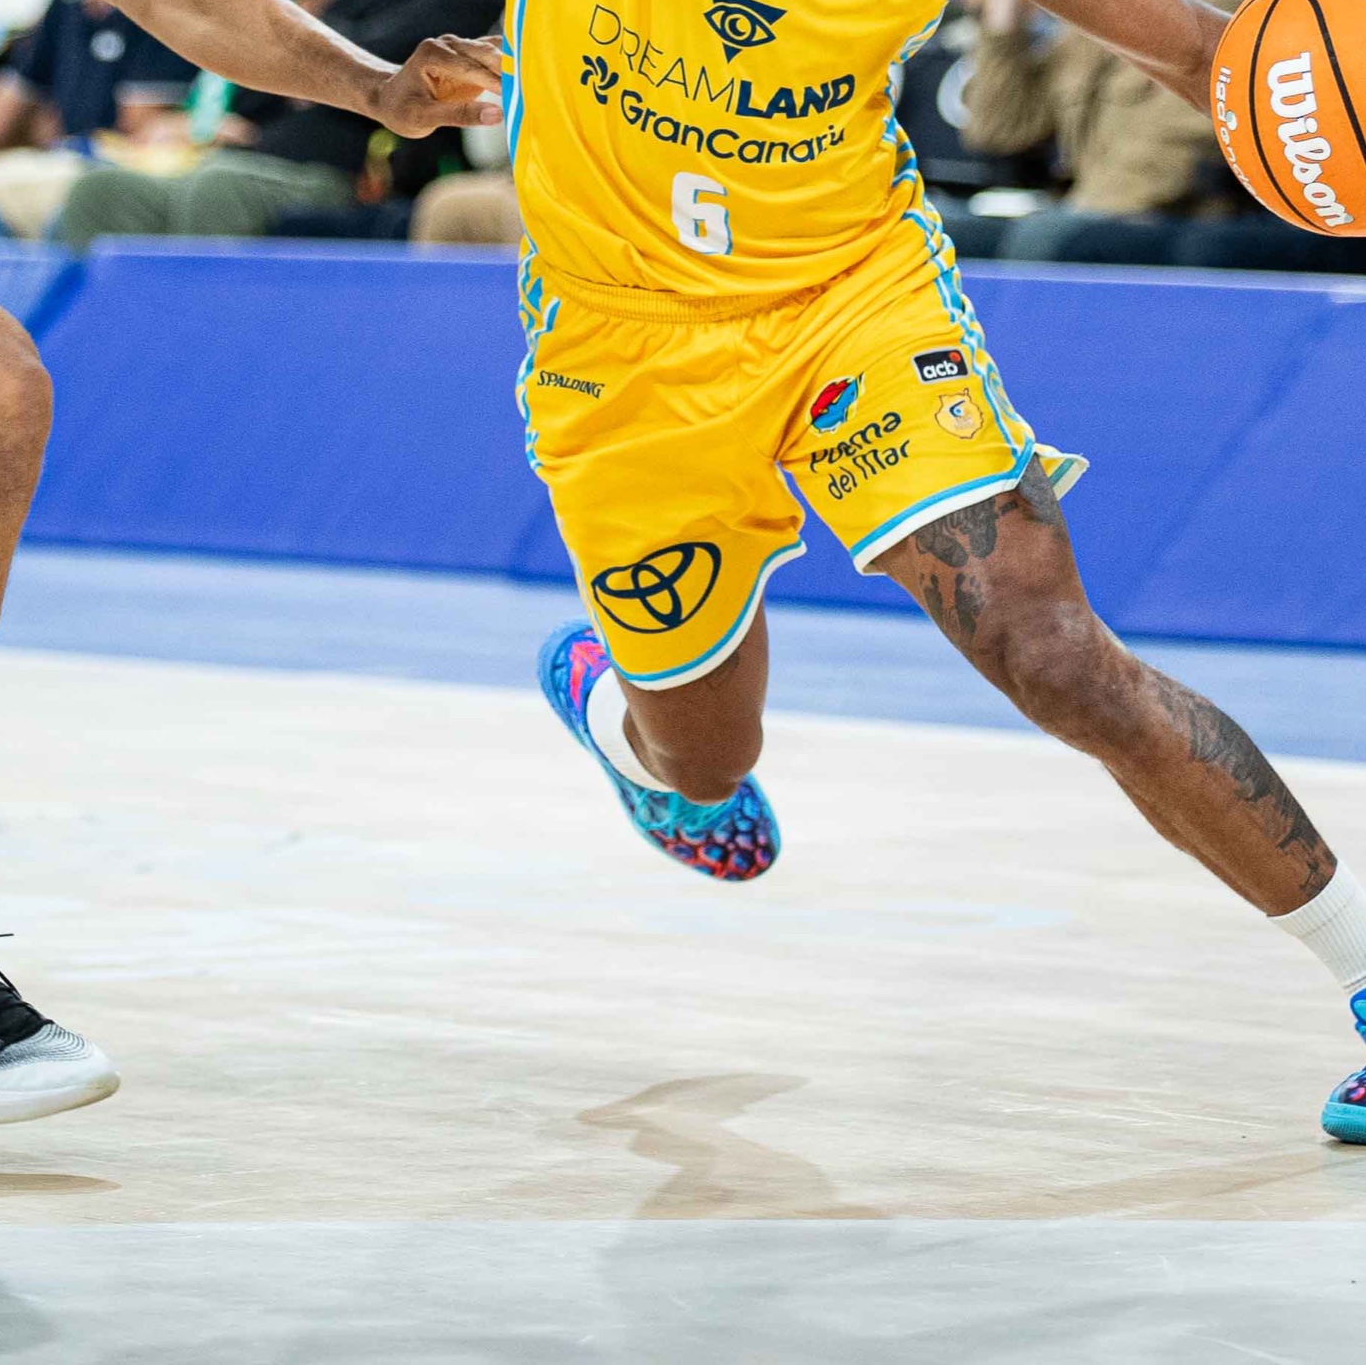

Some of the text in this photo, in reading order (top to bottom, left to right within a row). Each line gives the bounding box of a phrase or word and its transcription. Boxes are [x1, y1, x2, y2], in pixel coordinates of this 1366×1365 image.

[588, 4, 856, 120] DREAMLAND
[1216, 66, 1232, 122] liga
[1267, 51, 1355, 227] Wilson
[672, 171, 733, 255] 6
[537, 370, 605, 400] SPALDING
[922, 361, 959, 379] acb
[828, 440, 911, 500] del Mar
